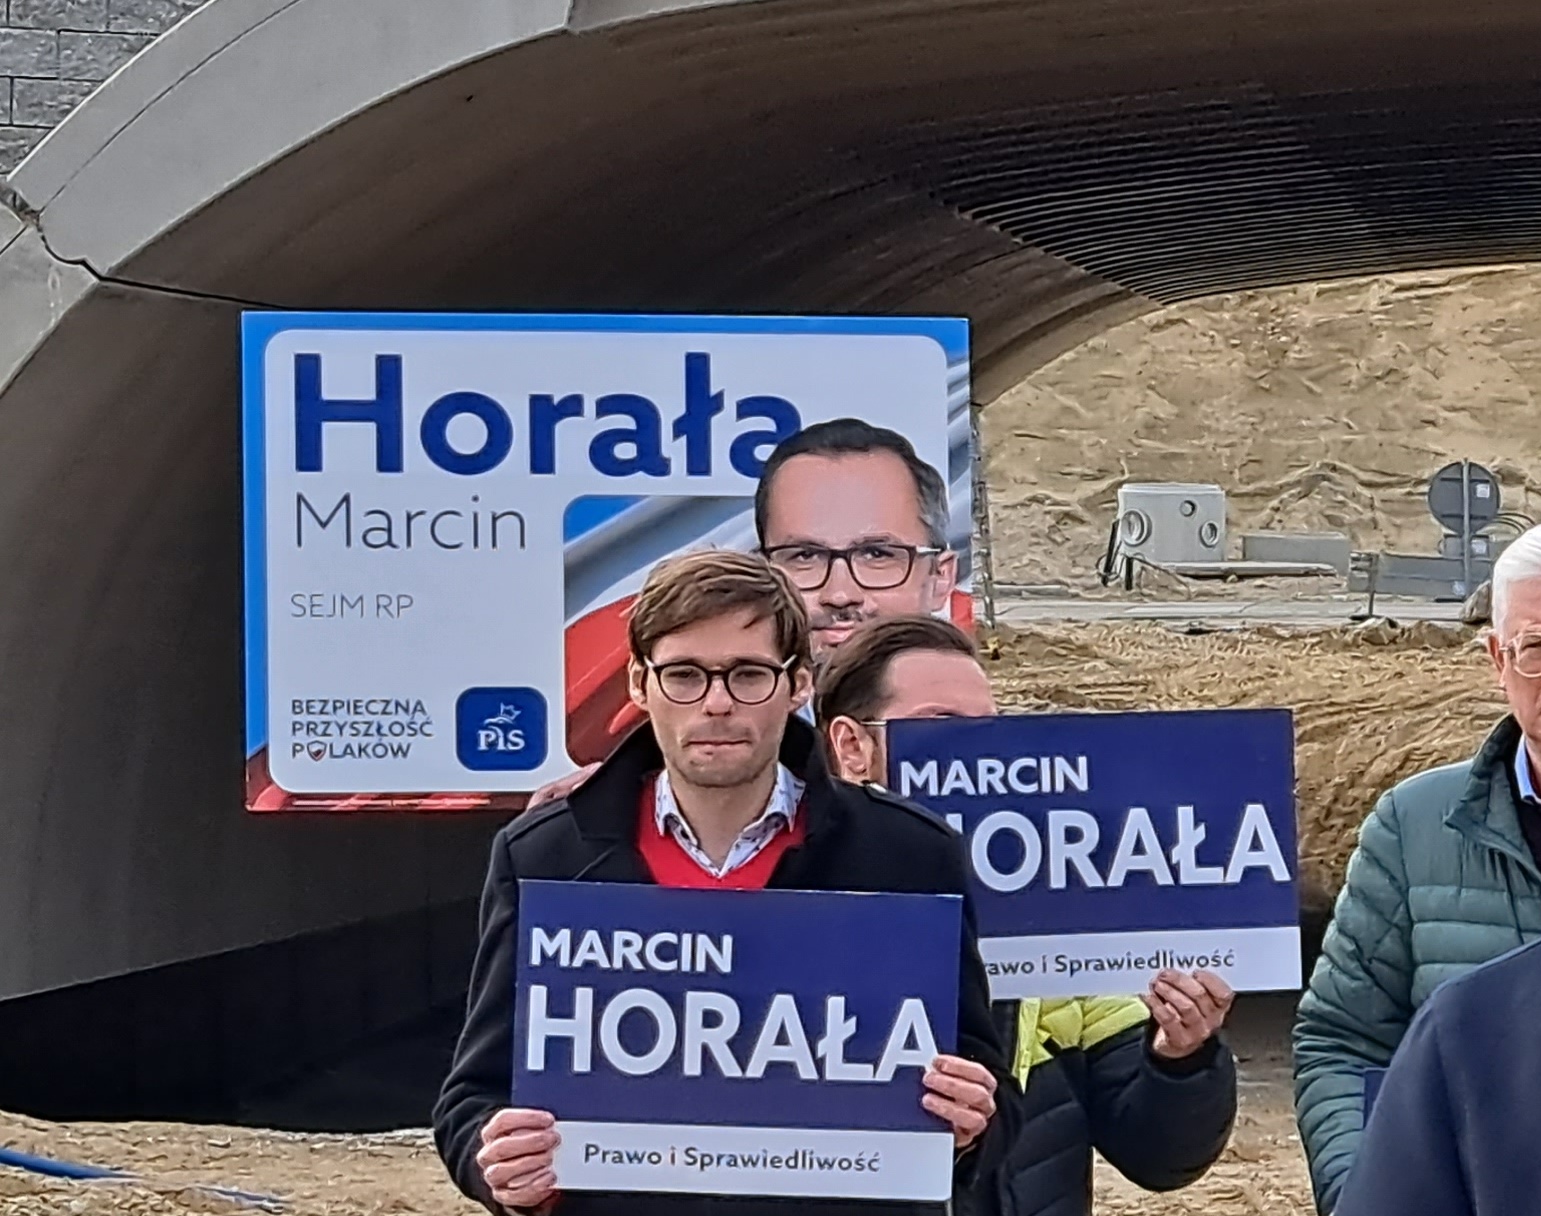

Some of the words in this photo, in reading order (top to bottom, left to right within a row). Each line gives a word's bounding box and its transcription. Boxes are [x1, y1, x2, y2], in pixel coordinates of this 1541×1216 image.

[292, 351, 803, 478] Horała
[293, 492, 527, 552] Marcin
[290, 593, 366, 620] SEJM
[375, 594, 414, 620] RP
[291, 698, 427, 717] BEZPIECZNA
[291, 716, 434, 738] PRZYSZŁOŚĆ
[900, 756, 1089, 799] MARCIN
[956, 804, 1291, 893] ORAŁA
[530, 927, 733, 974] MARCIN
[984, 961, 1035, 975] awo
[1054, 949, 1235, 979] Sprawiedliwość
[526, 984, 938, 1083] HORAŁA
[584, 1143, 662, 1168] Prawo
[669, 1146, 677, 1168] i
[683, 1144, 880, 1175] Sprawiedliwość
